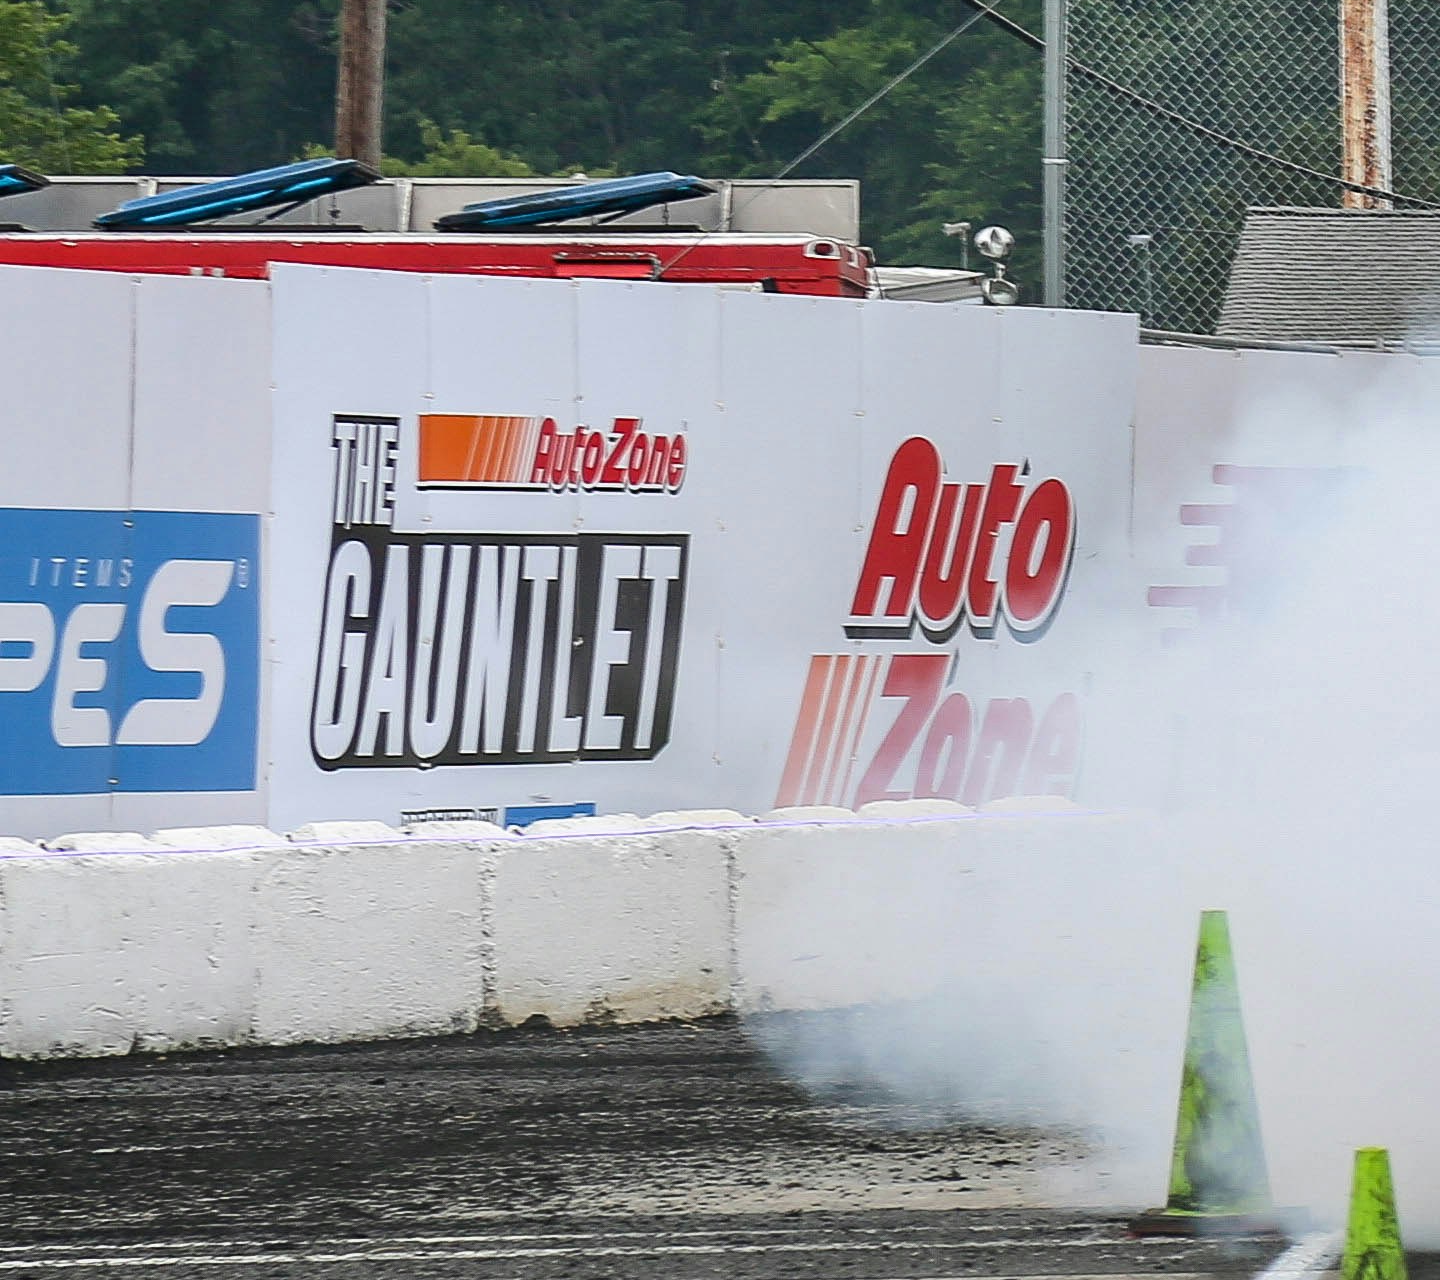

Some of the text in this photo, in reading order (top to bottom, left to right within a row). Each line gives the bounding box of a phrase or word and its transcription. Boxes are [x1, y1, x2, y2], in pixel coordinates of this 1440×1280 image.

[332, 419, 397, 529] THE
[530, 414, 688, 493] AutoZone
[28, 558, 134, 588] ITEMS
[848, 434, 1074, 630] Auto
[315, 535, 685, 762] GAUNTLET
